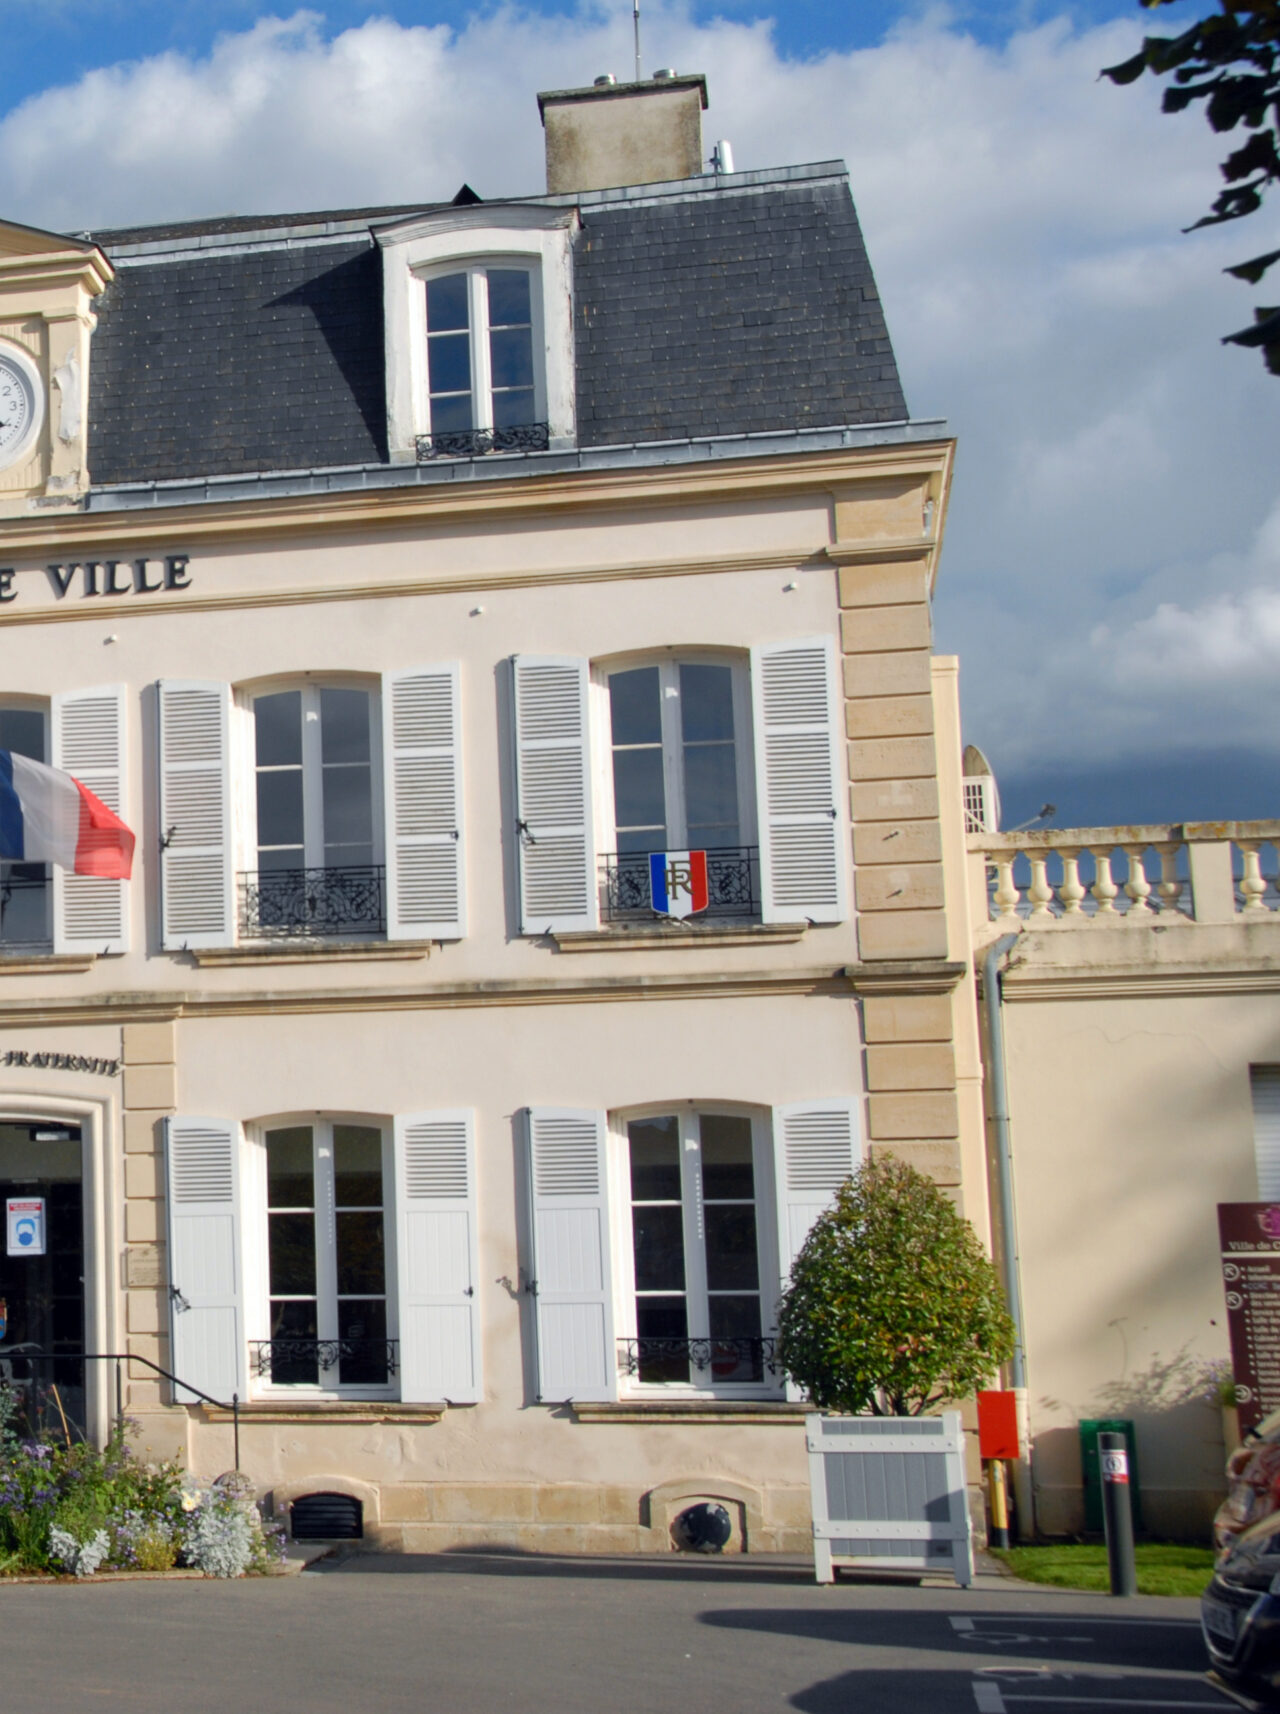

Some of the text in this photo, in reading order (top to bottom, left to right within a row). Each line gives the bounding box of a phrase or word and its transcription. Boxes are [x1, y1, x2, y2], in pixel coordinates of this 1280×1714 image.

[2, 386, 11, 396] 2
[10, 401, 17, 411] 3
[45, 555, 192, 600] VILLE
[1228, 1241, 1255, 1250] Ville
[1256, 1241, 1271, 1250] de
